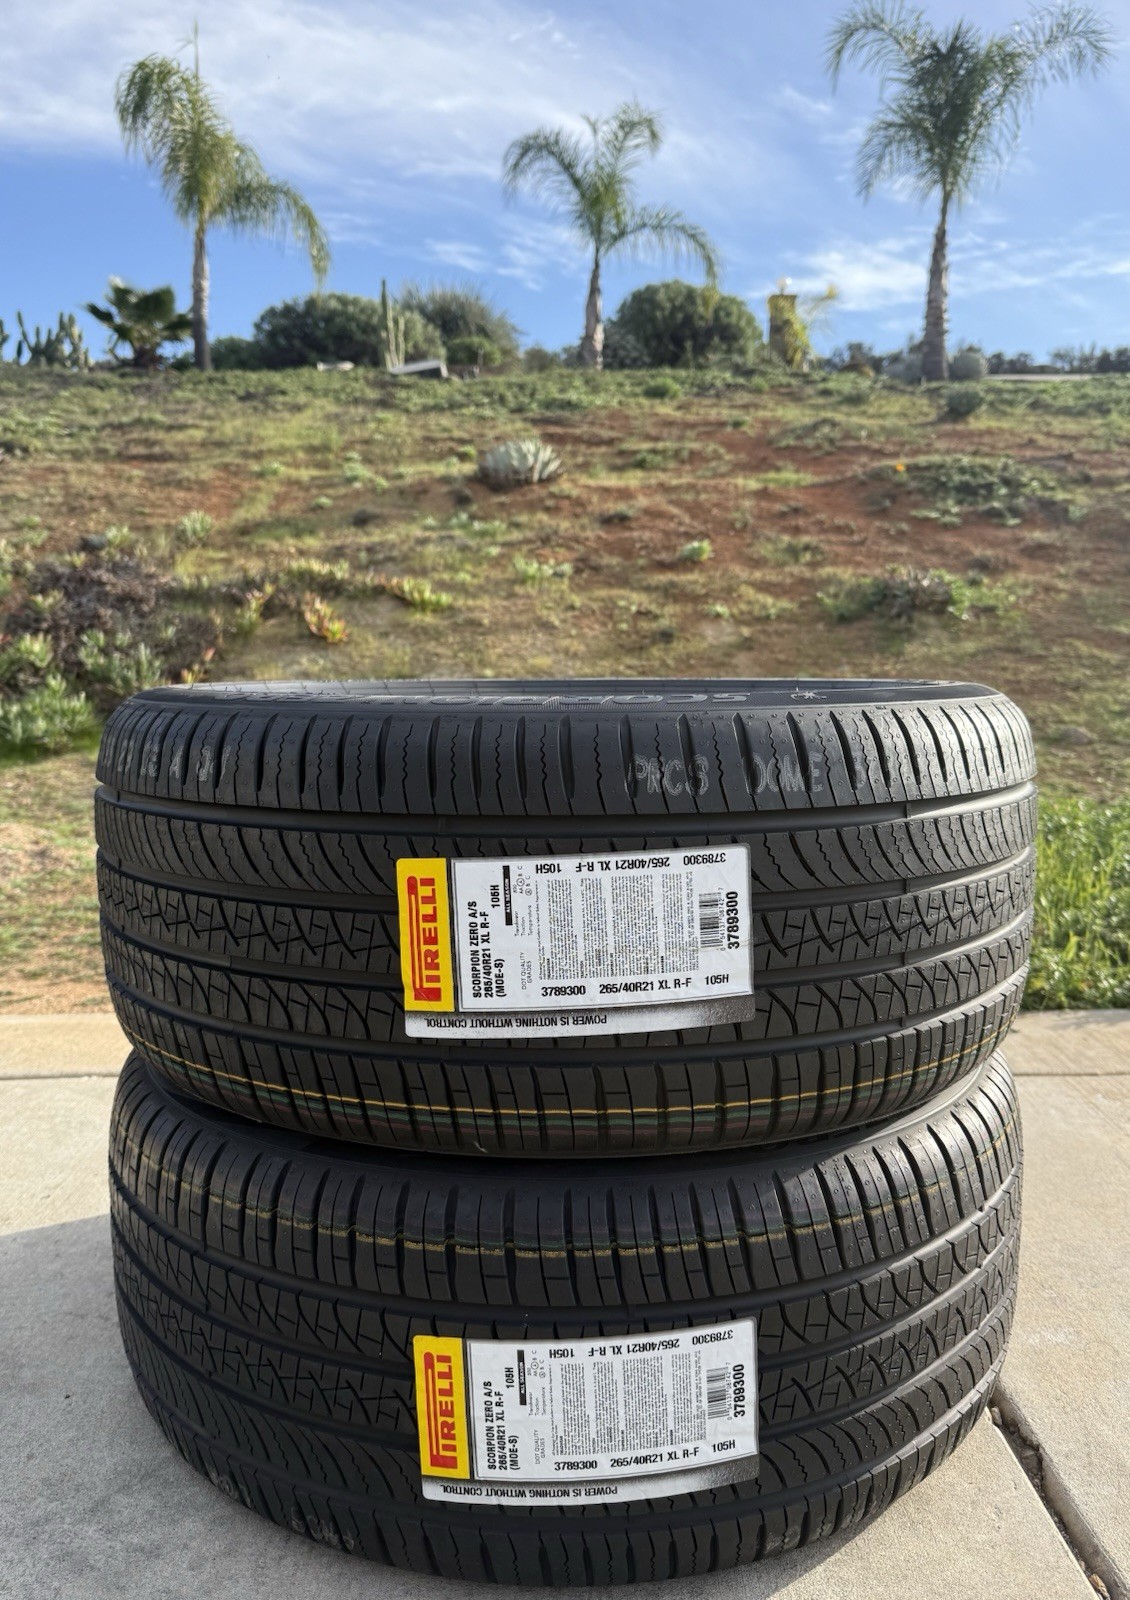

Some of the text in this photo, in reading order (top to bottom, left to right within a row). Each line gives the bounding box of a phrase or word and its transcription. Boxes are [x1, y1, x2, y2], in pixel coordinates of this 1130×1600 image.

[536, 852, 726, 874] 3789300 265/40R21 XL R-F 105H
[406, 875, 442, 1002] PIRELLI
[726, 891, 740, 950] 3789300
[467, 901, 482, 998] SCORPION ZERO A/S
[479, 911, 494, 998] 265/40R21 XL R-F
[493, 958, 507, 998] (MOE-S)
[541, 974, 729, 997] 3789300 265/40R21 XL R-F 105H
[424, 1015, 606, 1028] POWER IS NOTHING WITHOUT CONTROL
[550, 1330, 733, 1358] 3789300 265/40R21 XL R-F 105H
[504, 1367, 514, 1389] 105H
[733, 1364, 746, 1418] 3789300
[424, 1352, 457, 1469] PIRELLI
[484, 1381, 496, 1470] SCORPION ZERO A/S
[494, 1391, 508, 1470] 265/40R21 XL R-F
[508, 1435, 520, 1471] (MOE-S)
[554, 1439, 736, 1471] 3789300 265/40R21 XL R-F 105H
[440, 1484, 618, 1498] POWER IS NOTHING WITHOUT CONTROL
